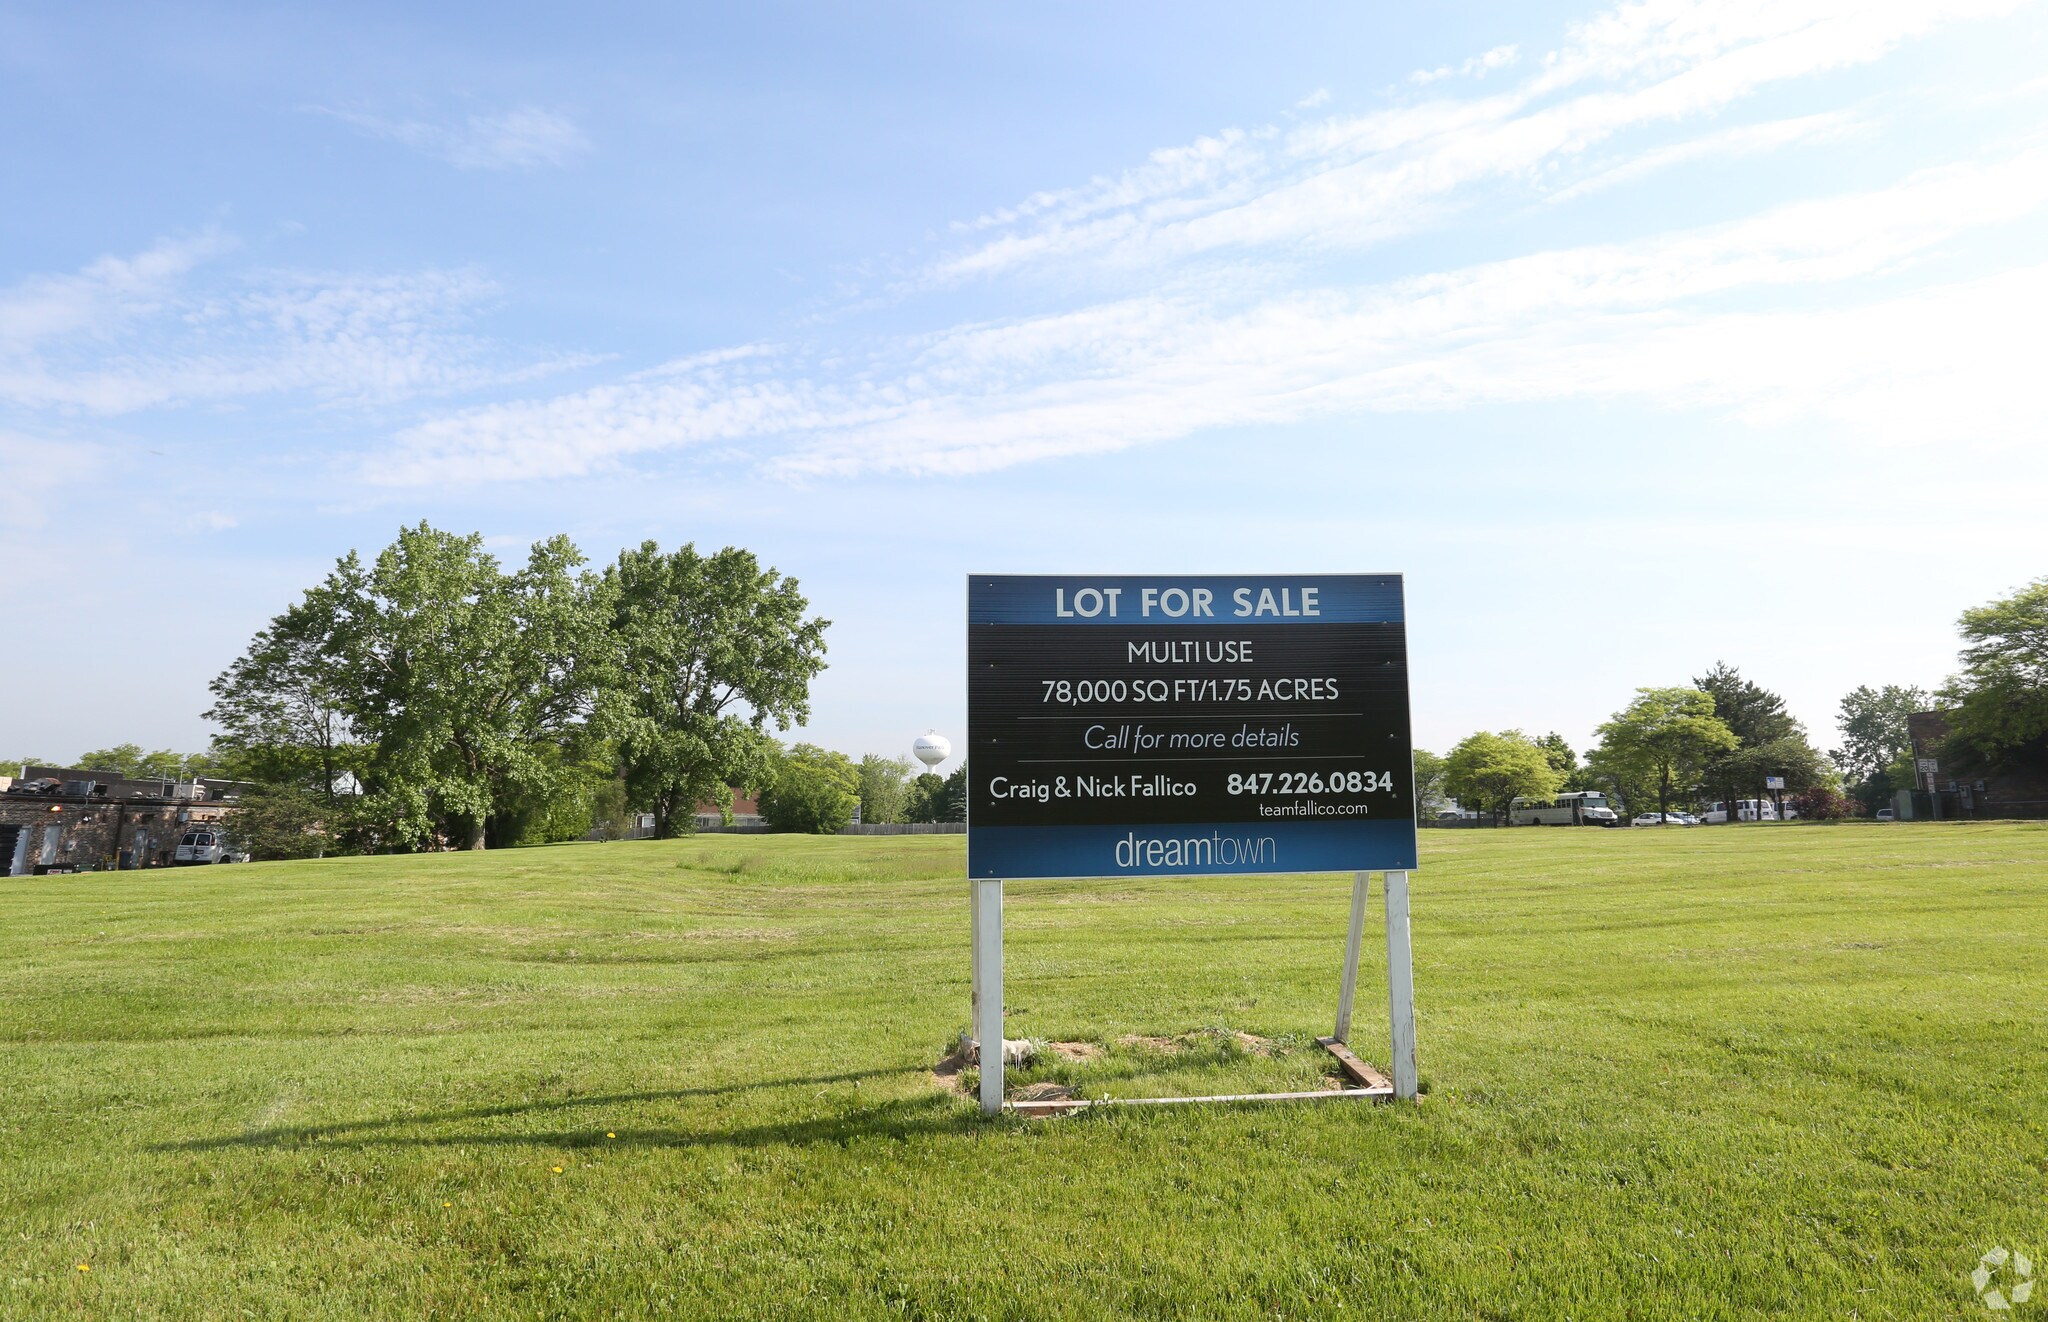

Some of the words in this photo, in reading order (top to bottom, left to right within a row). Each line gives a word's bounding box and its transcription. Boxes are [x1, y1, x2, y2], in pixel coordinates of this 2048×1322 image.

[1056, 587, 1121, 618] LOT
[1142, 587, 1214, 618] FOR
[1233, 587, 1320, 617] SALE
[1128, 641, 1200, 663] MULTI
[1206, 641, 1253, 663] USE
[1042, 679, 1127, 706] 78,000
[1133, 679, 1168, 703] SQ
[1175, 678, 1252, 702] FT/1.75
[1257, 678, 1339, 701] ACRES
[1085, 724, 1130, 750] Call
[1133, 724, 1164, 753] for
[1169, 734, 1226, 749] more
[1231, 723, 1299, 748] details
[989, 776, 1050, 802] Craig
[1055, 776, 1071, 798] &
[1077, 775, 1126, 797] Nick
[1131, 775, 1197, 797] Fallico
[1227, 771, 1393, 796] 847.226.0834
[1259, 800, 1368, 816] teamfallico.com
[1115, 831, 1276, 868] dreamtown
